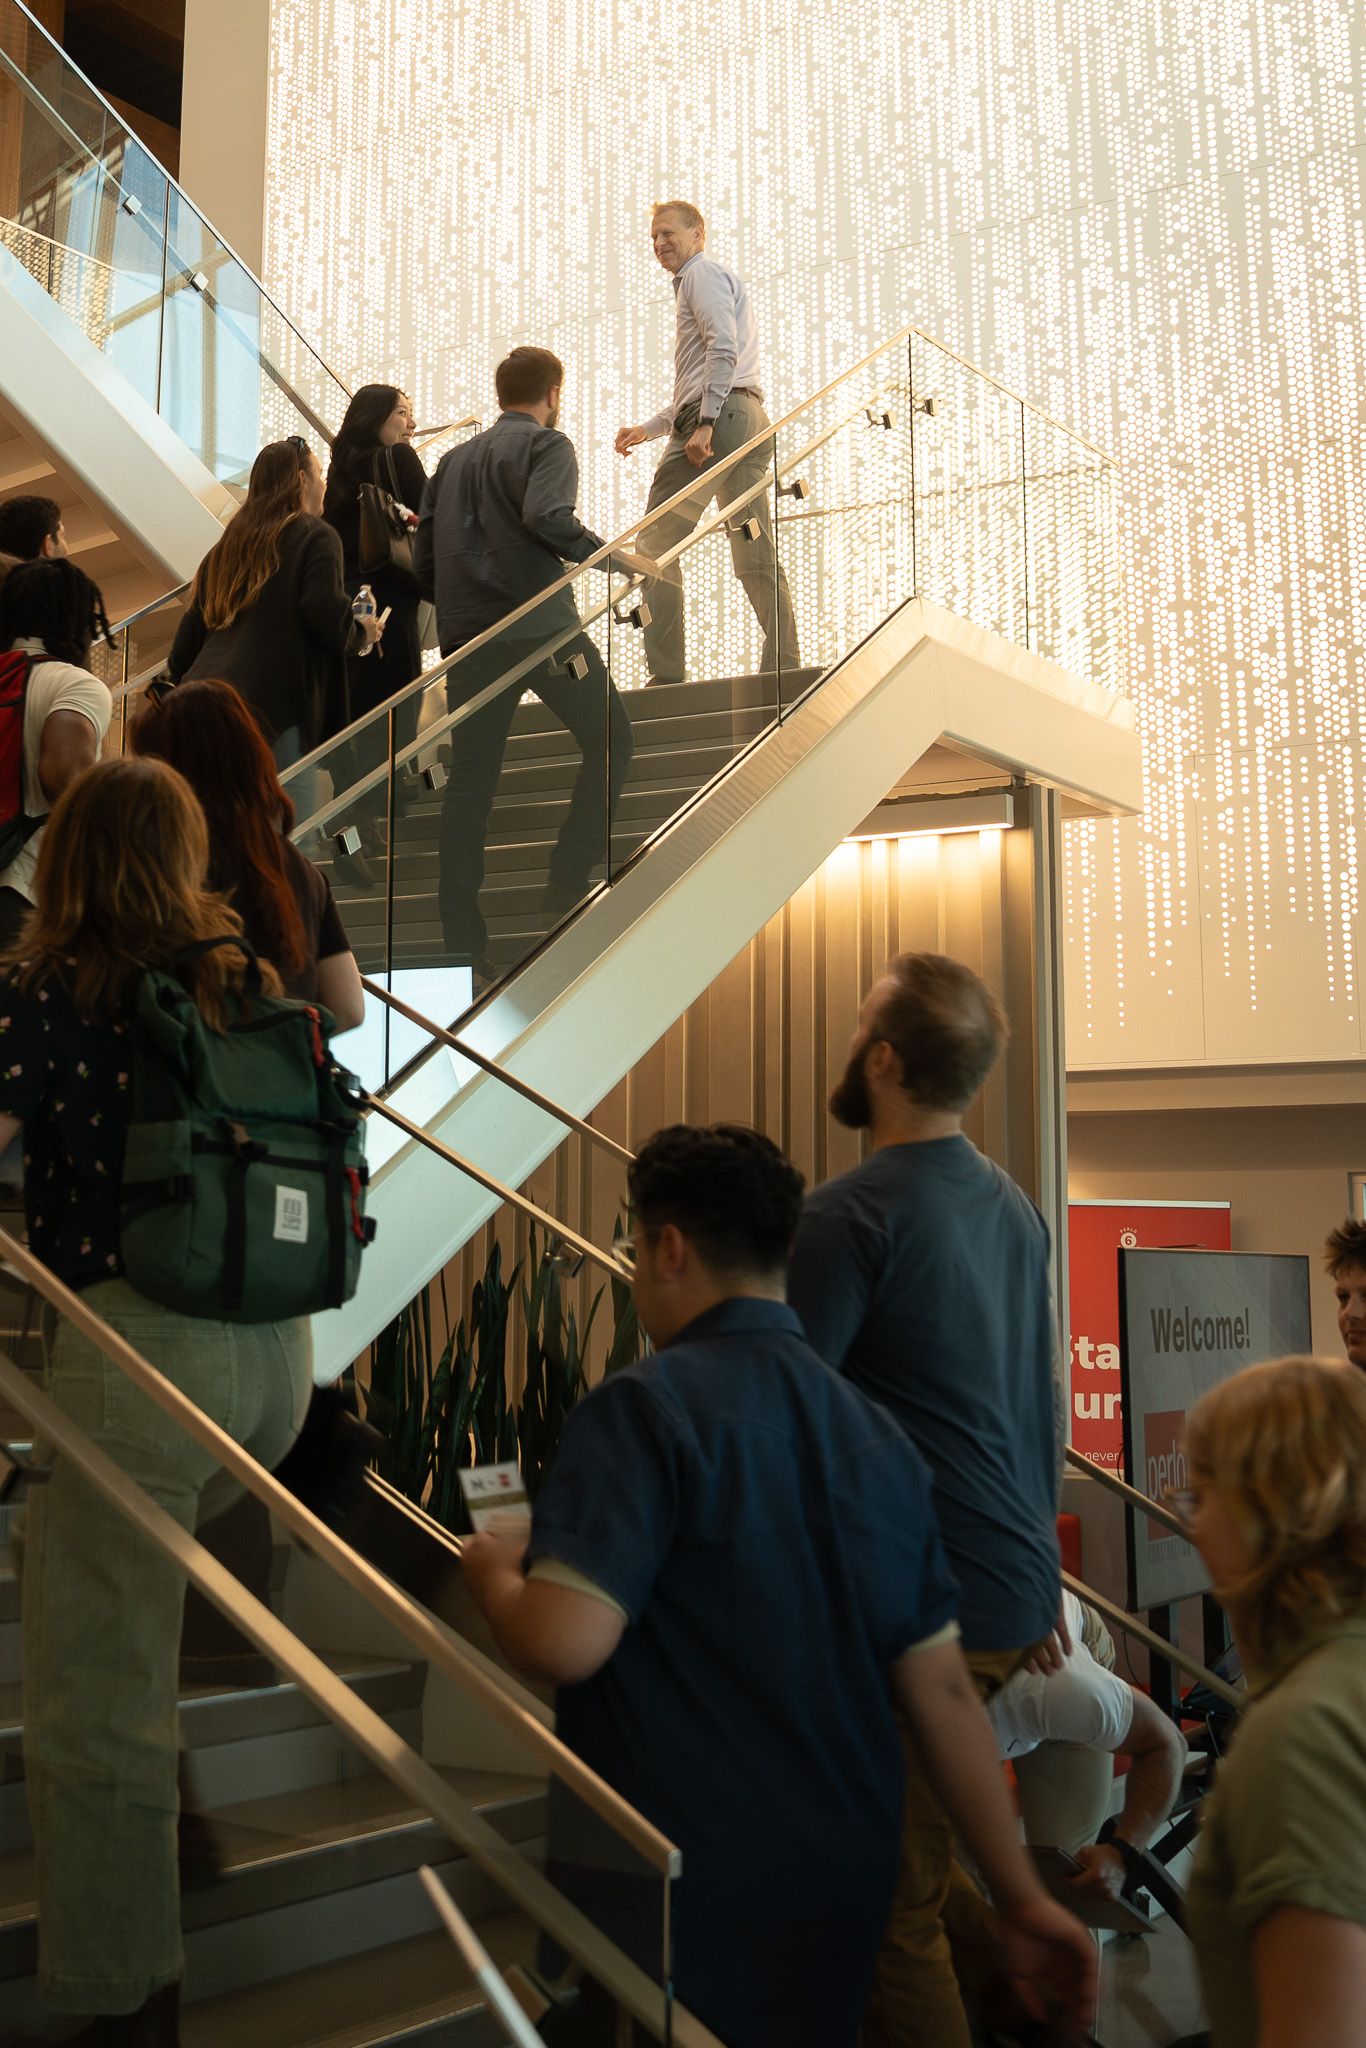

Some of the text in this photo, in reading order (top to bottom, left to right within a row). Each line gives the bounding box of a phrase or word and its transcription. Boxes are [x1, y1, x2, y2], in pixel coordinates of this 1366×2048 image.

[1125, 1236, 1132, 1246] 6
[1150, 1305, 1250, 1353] Welcome!
[1084, 1451, 1119, 1461] never
[1148, 1439, 1187, 1501] perlo
